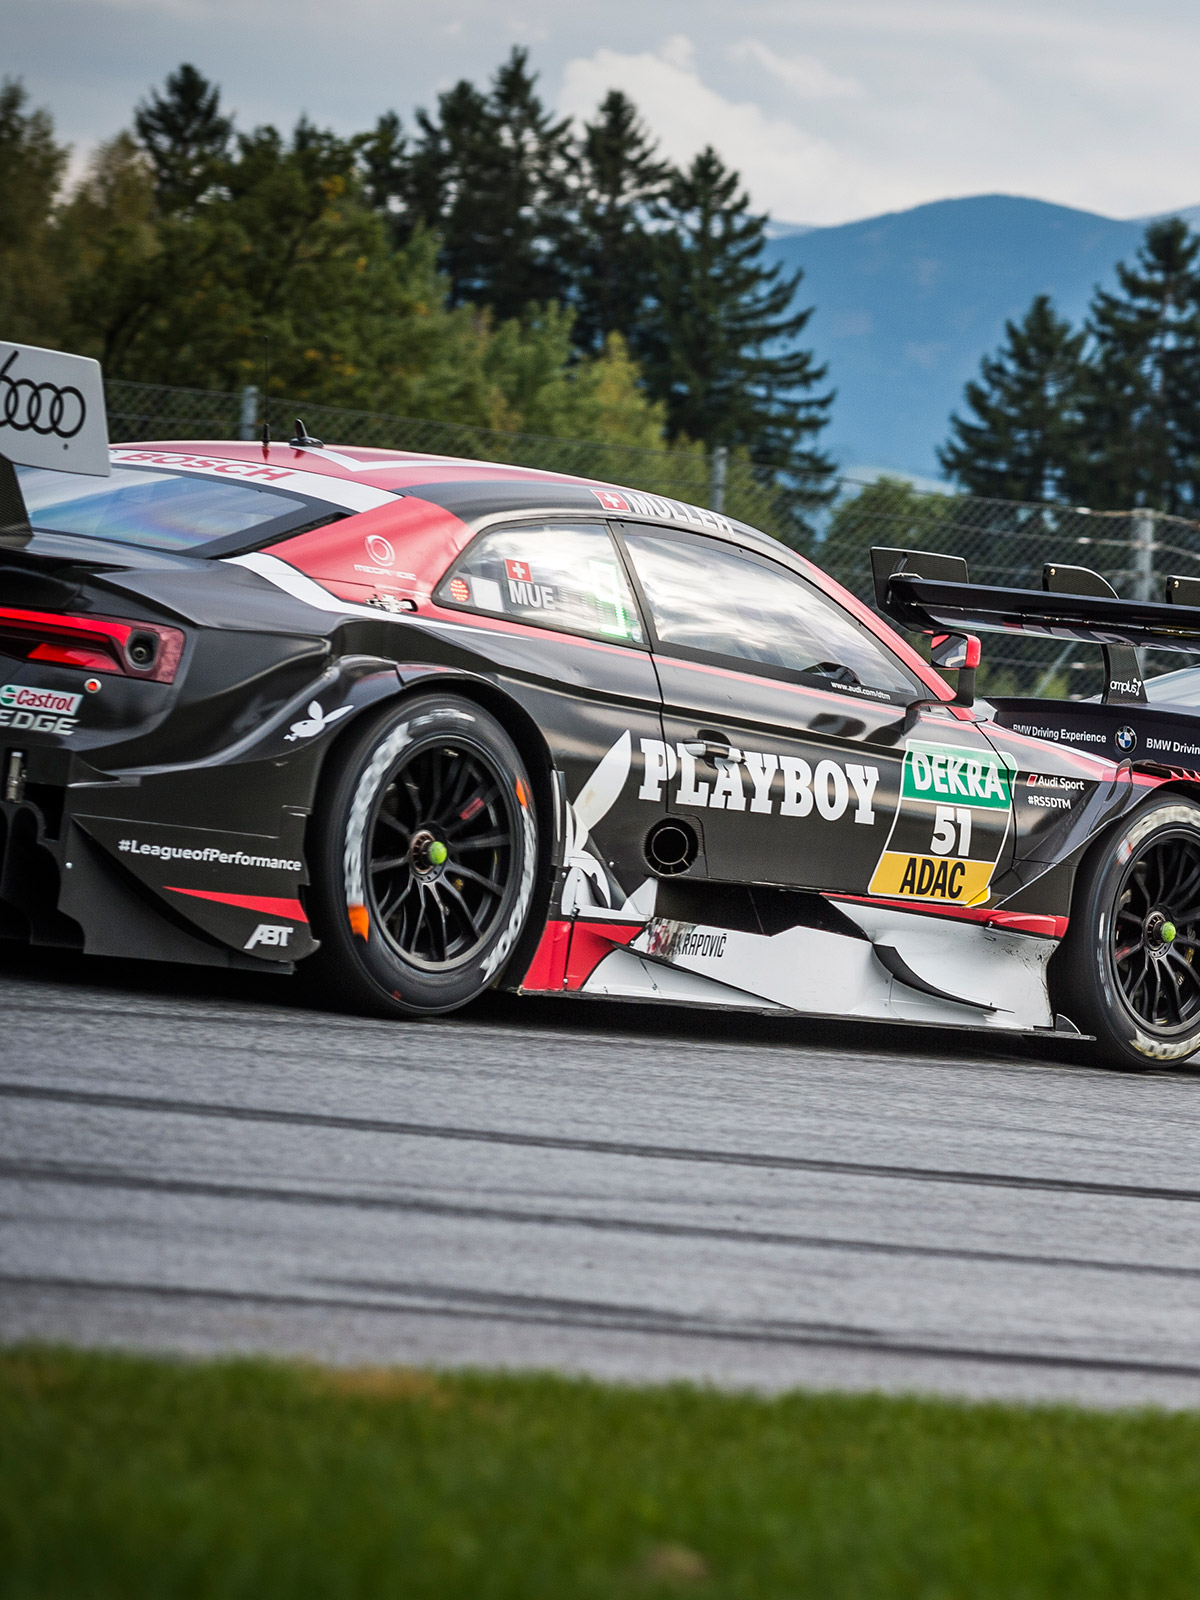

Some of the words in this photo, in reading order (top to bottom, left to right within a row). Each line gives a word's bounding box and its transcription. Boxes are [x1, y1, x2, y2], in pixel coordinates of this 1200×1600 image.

[120, 453, 296, 481] BOSCH
[508, 580, 554, 610] MUE
[831, 682, 890, 700] www.audi.com/dtm
[1110, 679, 1137, 694] amplus
[16, 689, 74, 711] Castrol
[0, 709, 79, 735] EDGE
[1032, 726, 1059, 740] Driving
[1060, 729, 1106, 743] Experience
[1146, 738, 1171, 751] BMW
[638, 738, 880, 825] PLAYBOY
[912, 751, 1006, 800] DEKRA
[1037, 775, 1058, 788] Audi
[1060, 778, 1084, 791] Sport
[1028, 795, 1071, 809] #RS5DTM
[930, 806, 971, 856] 51
[118, 839, 302, 871] #LeagueofPerformance
[899, 857, 965, 899] ADAC
[244, 924, 293, 949] ABT
